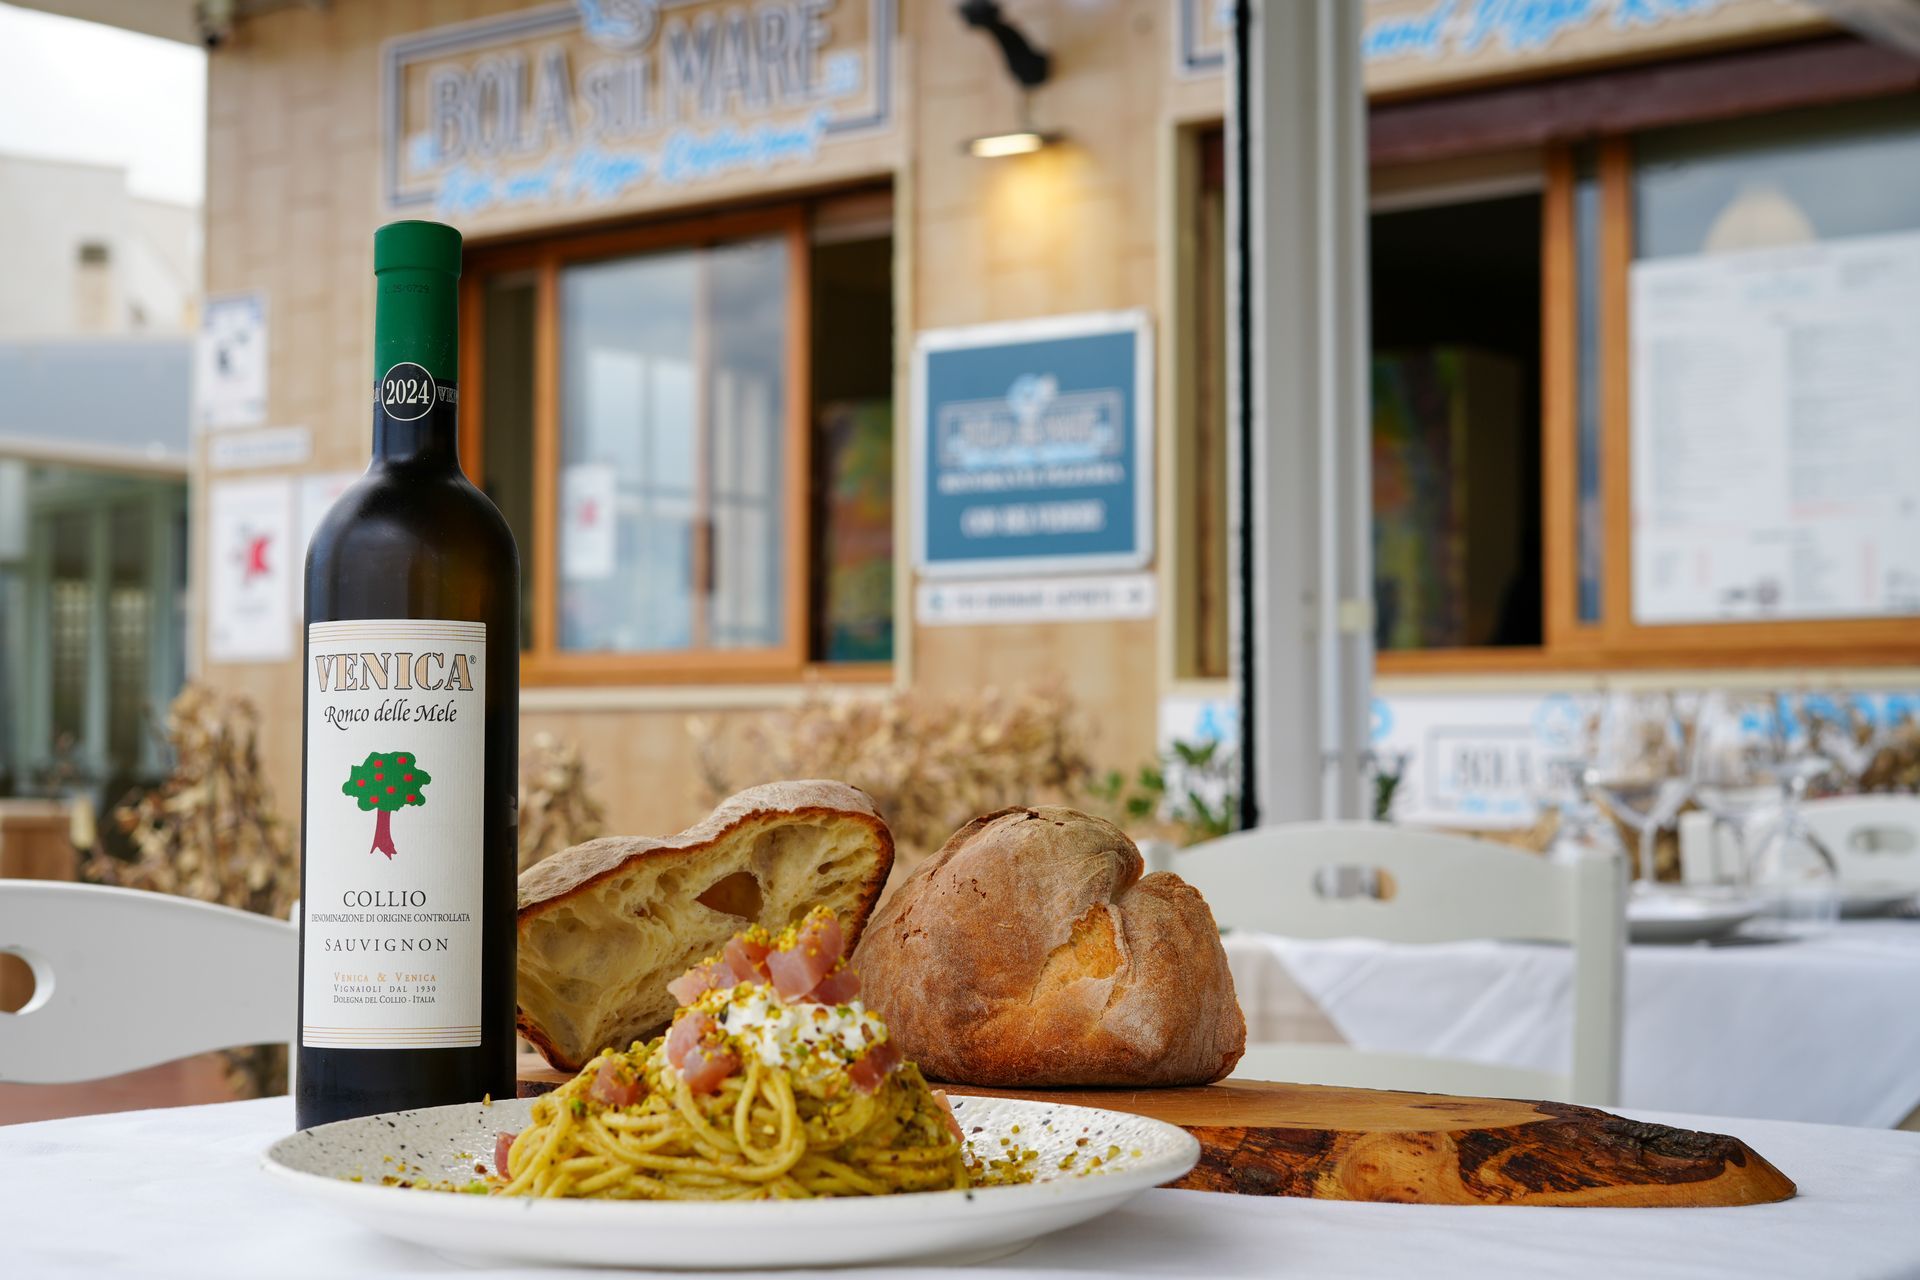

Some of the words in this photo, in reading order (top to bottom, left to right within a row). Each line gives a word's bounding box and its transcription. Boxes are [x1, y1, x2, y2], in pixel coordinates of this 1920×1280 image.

[430, 46, 574, 162] BOLA
[665, 0, 838, 119] MARE
[386, 379, 430, 405] 2024
[324, 704, 370, 731] Ronco
[374, 698, 411, 723] delle
[414, 699, 458, 723] Mele
[343, 890, 427, 908] COLLIO
[311, 913, 365, 923] DENOMINAZIONE
[366, 913, 375, 923] DI
[376, 913, 412, 923] ORIGINE
[413, 913, 471, 923] CONTROLLATA
[325, 938, 449, 952] SAUVIGNON
[377, 972, 387, 983] &
[389, 985, 408, 993] DAL
[364, 995, 378, 1004] DEL
